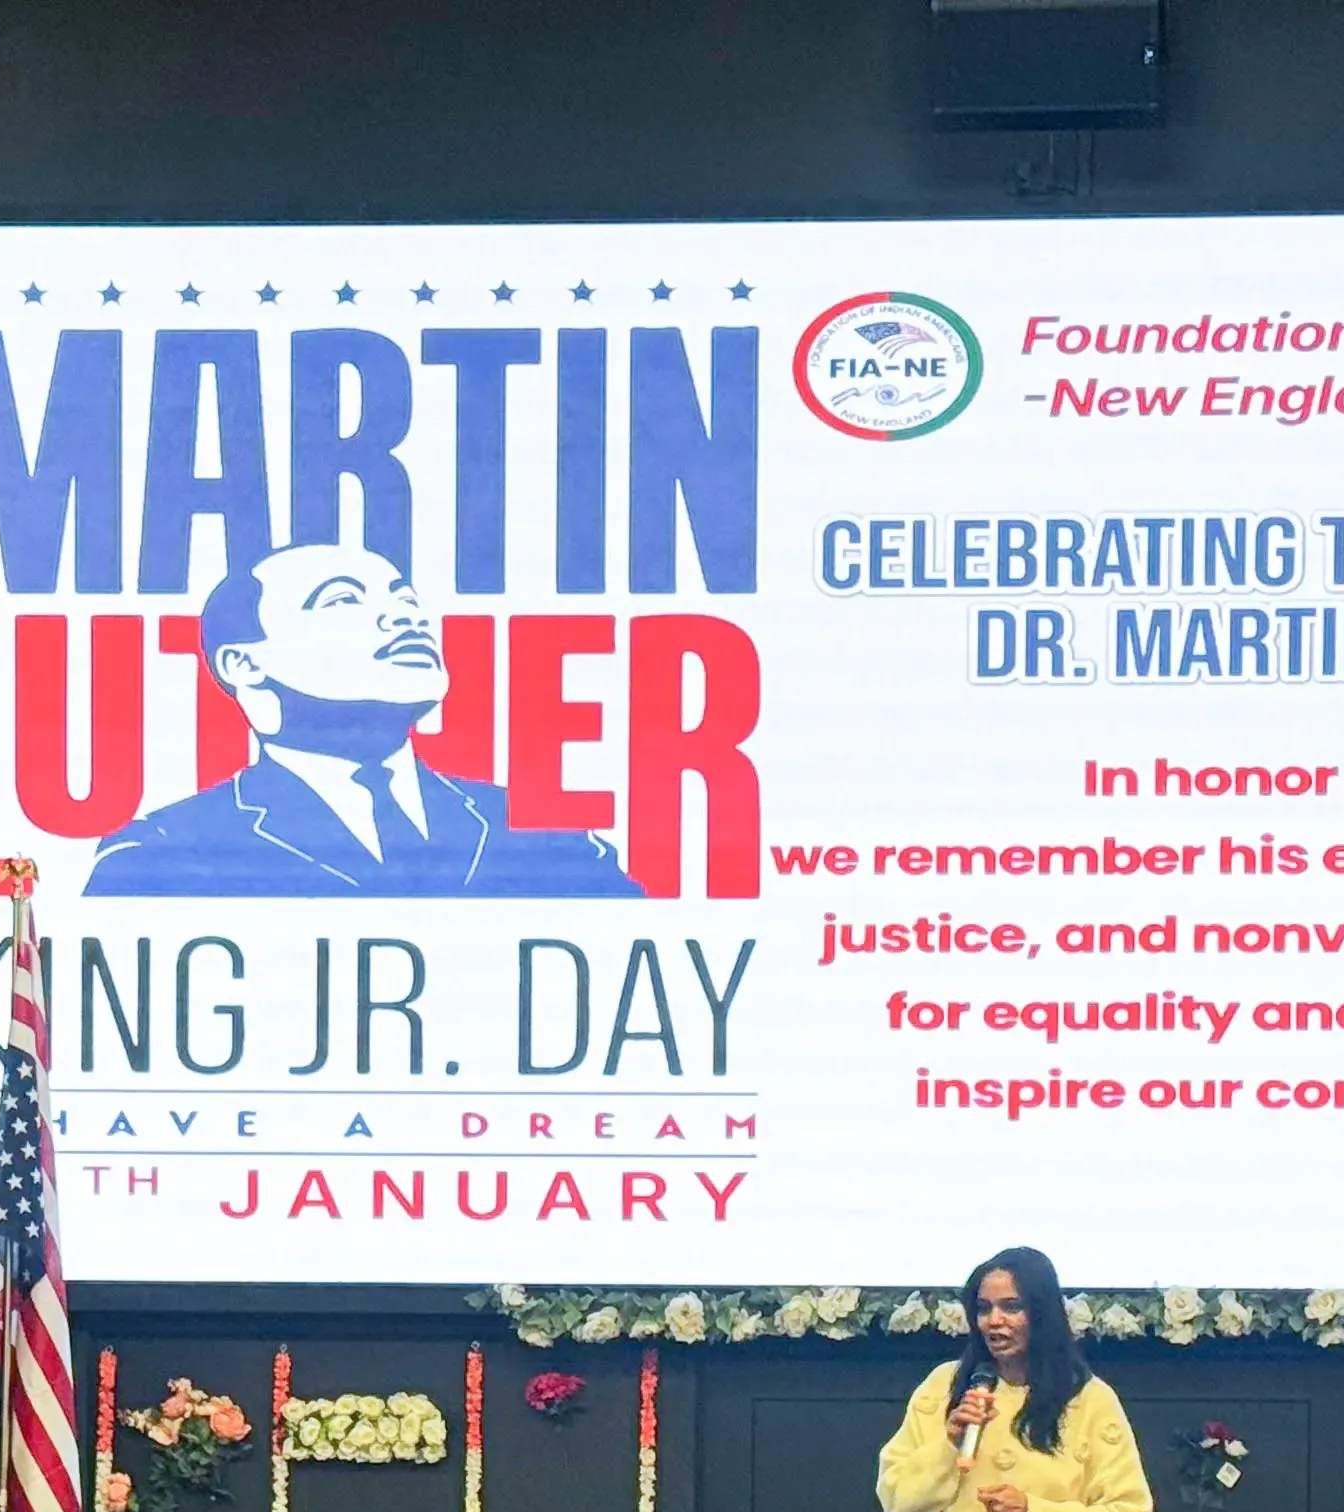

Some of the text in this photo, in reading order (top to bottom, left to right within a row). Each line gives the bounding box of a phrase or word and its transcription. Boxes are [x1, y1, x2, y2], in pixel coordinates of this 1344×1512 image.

[828, 357, 949, 379] FIA-NE
[1023, 376, 1186, 418] -New
[821, 517, 1296, 590] CELEBRATING
[976, 609, 1087, 679] DR.
[1084, 759, 1140, 797] In
[1153, 757, 1338, 797] honor
[770, 844, 859, 876] we
[873, 836, 1206, 876] remember
[1218, 832, 1310, 876] his
[818, 911, 1042, 966] justice,
[1054, 914, 1179, 954] and
[288, 936, 461, 1077] JR.
[517, 937, 758, 1078] DAY
[885, 990, 971, 1031] for
[982, 990, 1241, 1044] equality
[914, 1067, 1127, 1121] inspire
[1138, 1079, 1244, 1110] our
[343, 1111, 374, 1140] A
[461, 1112, 758, 1140] DREAM
[218, 1168, 750, 1222] JANUARY
